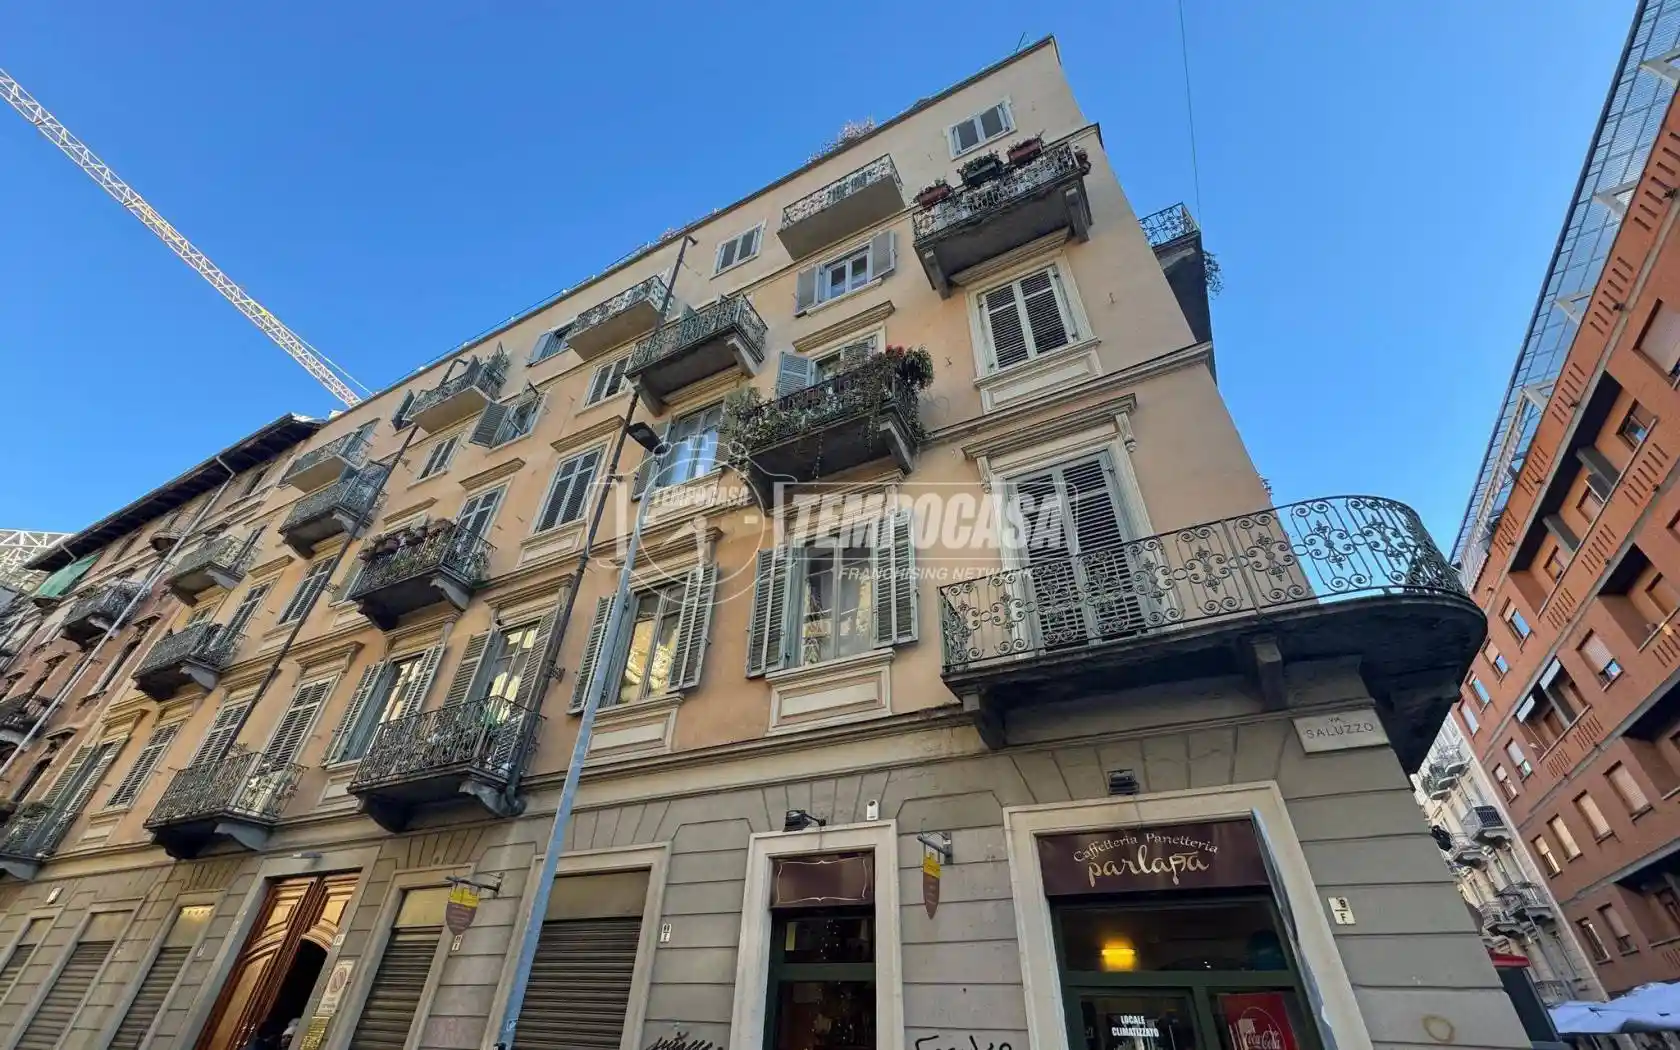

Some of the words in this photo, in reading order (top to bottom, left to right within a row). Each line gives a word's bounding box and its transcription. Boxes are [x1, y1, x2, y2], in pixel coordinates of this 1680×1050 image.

[1306, 722, 1375, 739] SALUZZO
[1073, 834, 1139, 862] Caffetteria
[1146, 832, 1219, 854] Panetteria
[1120, 1014, 1145, 1025] LOCALE
[1111, 1026, 1160, 1038] CLIMATIZZATO
